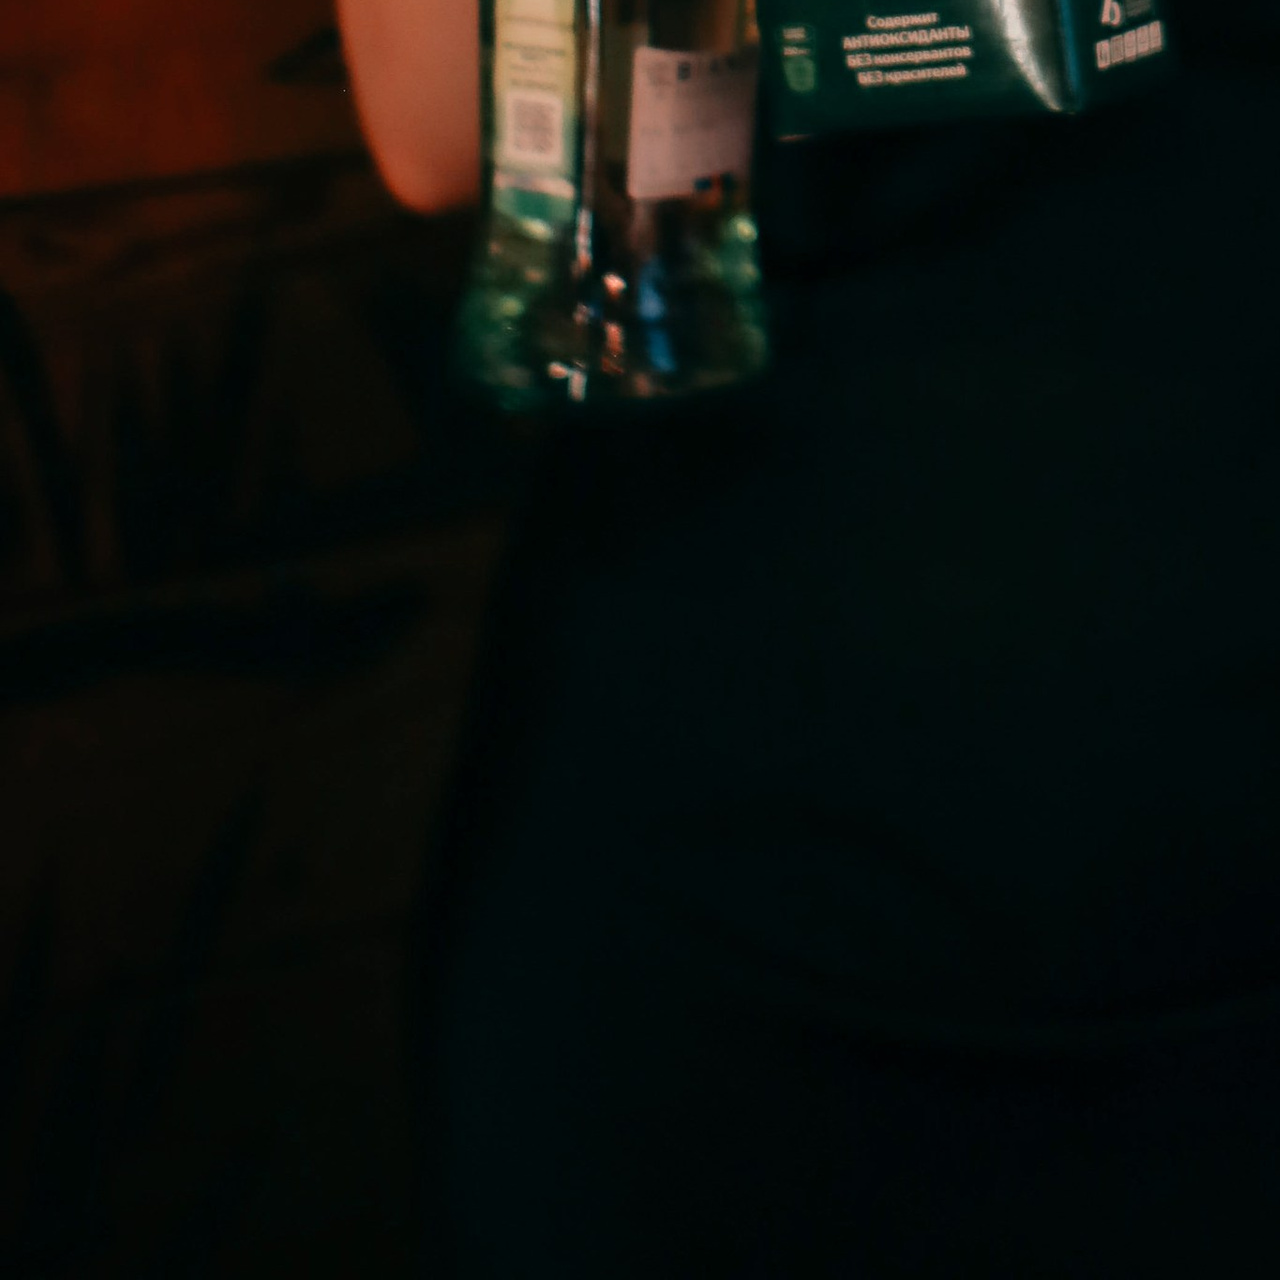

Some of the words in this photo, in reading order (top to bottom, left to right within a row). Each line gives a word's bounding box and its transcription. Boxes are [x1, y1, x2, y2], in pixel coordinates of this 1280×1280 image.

[865, 12, 938, 30] Содержит
[843, 25, 970, 51] АНТИОКСИДАНТЫ
[846, 53, 873, 69] БЕЗ
[873, 45, 973, 67] консервантов
[857, 71, 884, 87] БЕЗ
[884, 63, 968, 84] красителей
